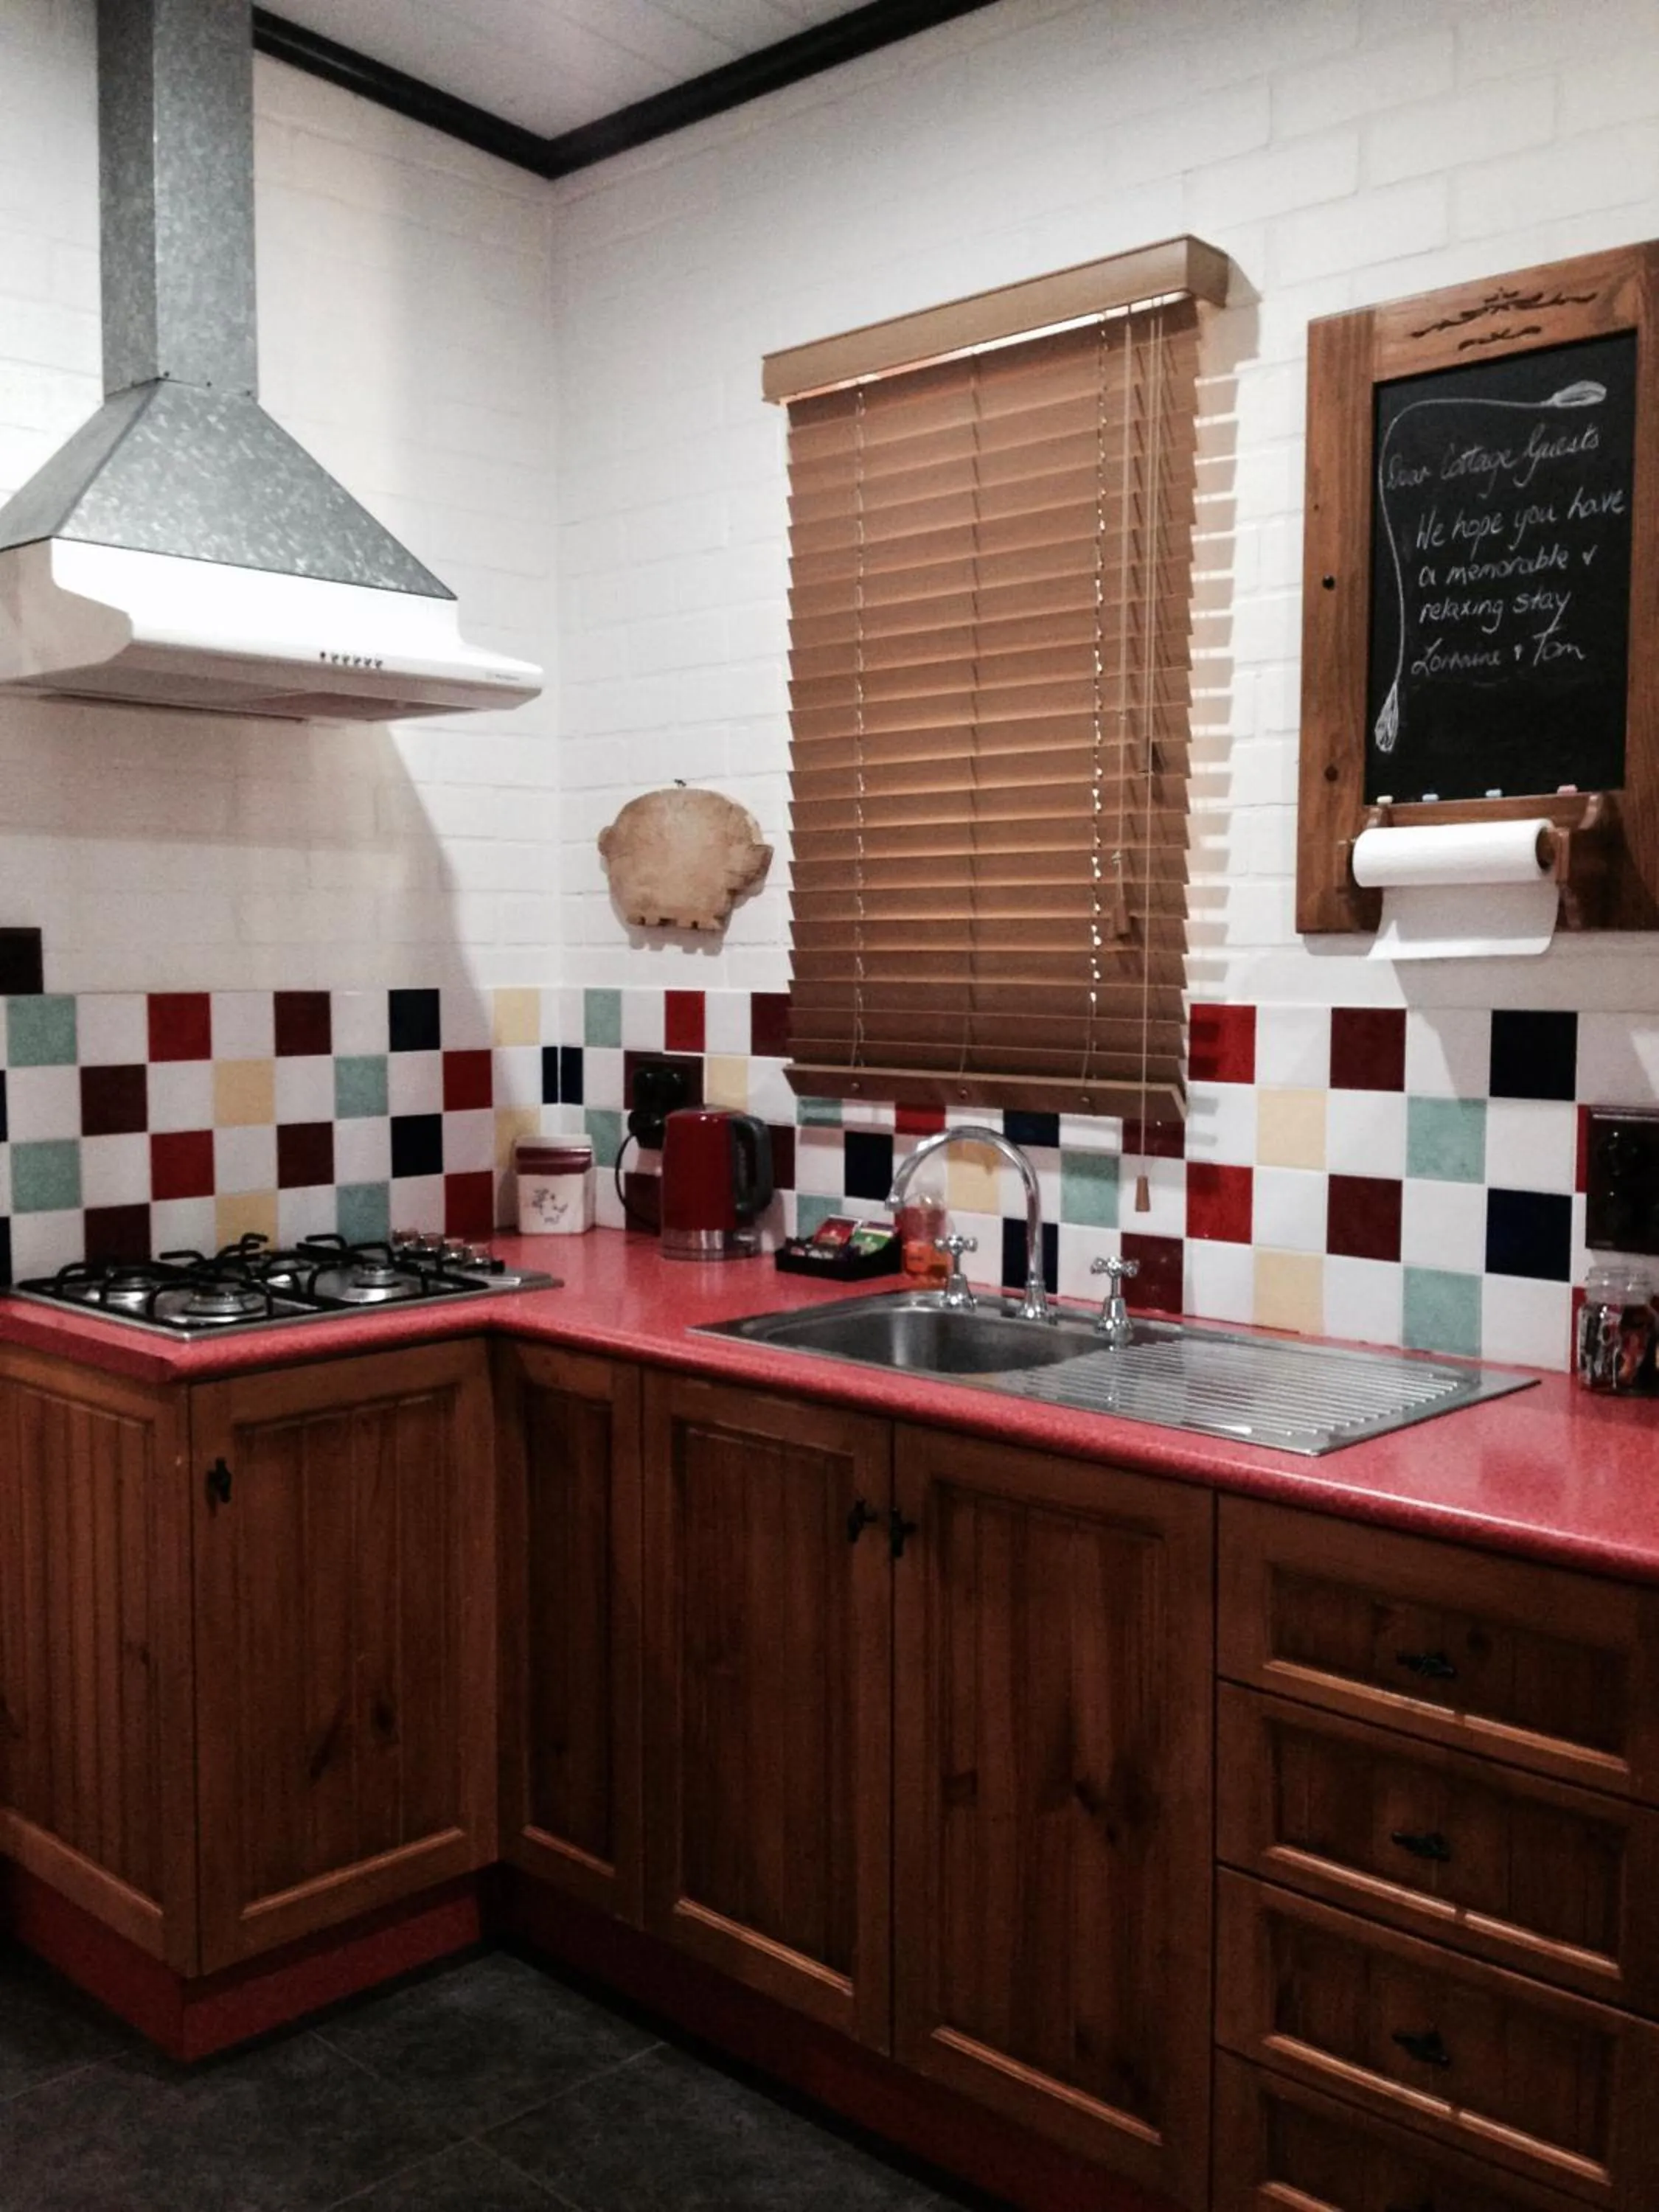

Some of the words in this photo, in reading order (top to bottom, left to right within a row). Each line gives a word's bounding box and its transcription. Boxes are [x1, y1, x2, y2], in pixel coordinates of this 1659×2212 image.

[1513, 422, 1599, 487] Guests
[1416, 509, 1445, 550] We
[1452, 509, 1503, 560] hope
[1509, 505, 1557, 551] you
[1568, 487, 1625, 519] have
[1419, 566, 1436, 588] a
[1446, 543, 1568, 585] memorable
[1419, 597, 1503, 634] relaxing
[1513, 588, 1571, 631] stay
[1533, 626, 1585, 666] Tom
